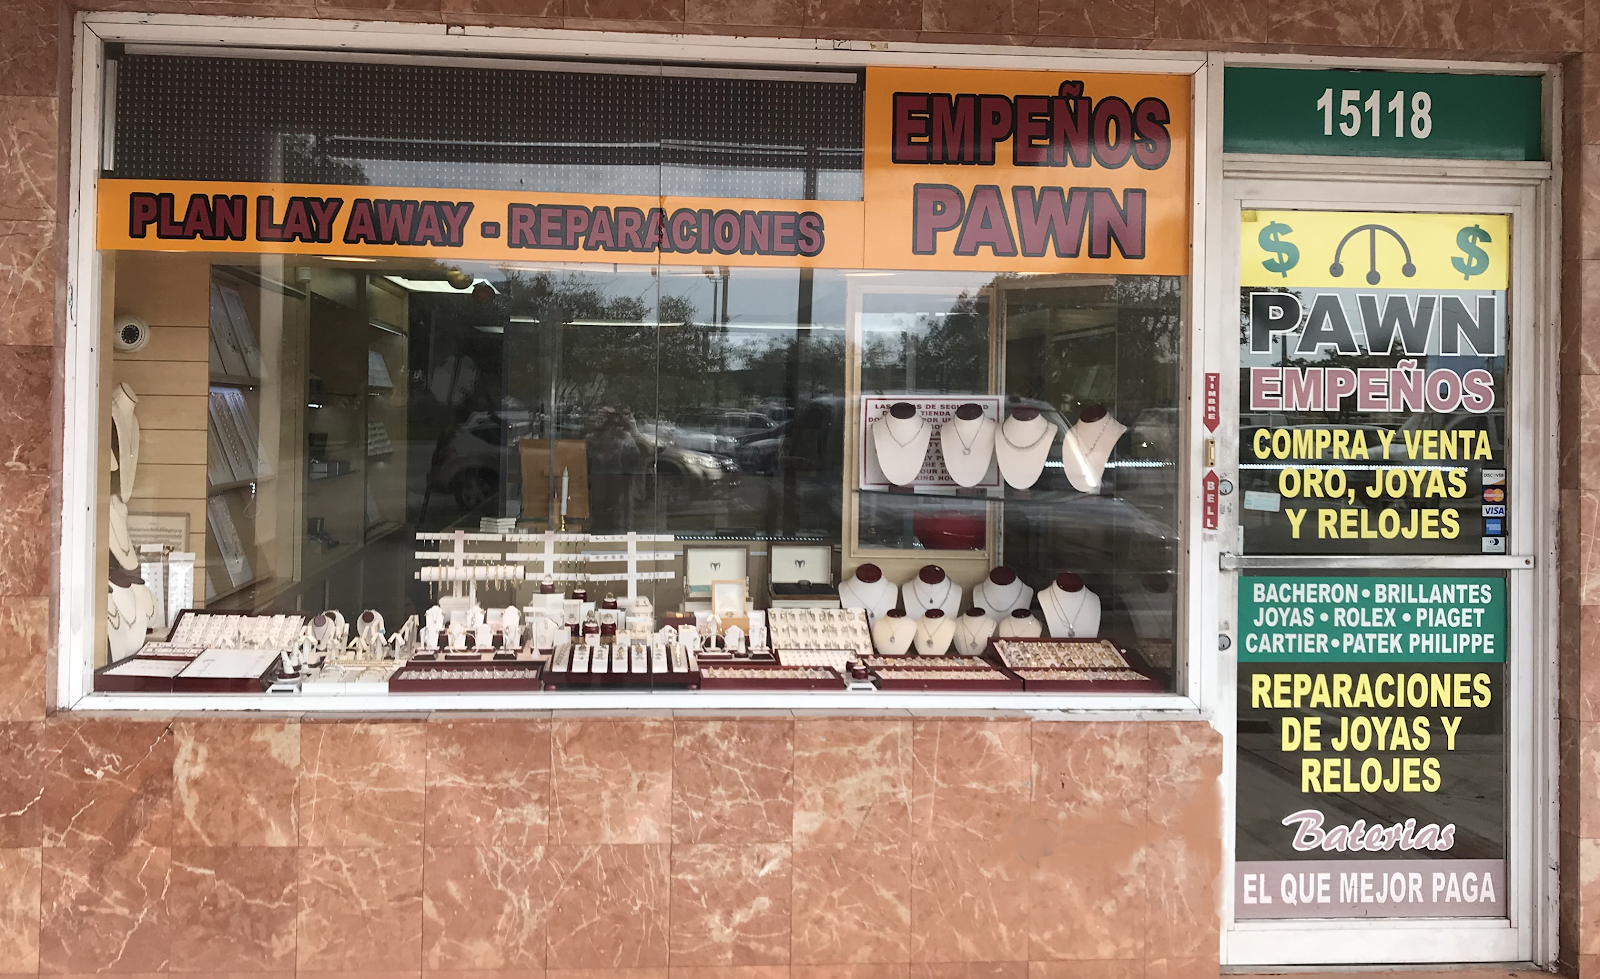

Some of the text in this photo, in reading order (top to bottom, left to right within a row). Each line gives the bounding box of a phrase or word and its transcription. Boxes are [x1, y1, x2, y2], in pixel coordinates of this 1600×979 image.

[892, 81, 1171, 170] EMPEÑOS
[1316, 88, 1433, 139] 15118
[129, 192, 247, 241] PLAN
[256, 195, 344, 243] LAY
[343, 198, 474, 247] AWAY
[507, 202, 825, 257] REPARACIONES
[912, 183, 1146, 259] PAWN
[1249, 292, 1498, 357] PAWN
[1207, 375, 1217, 420] TIMBRE
[1249, 359, 1495, 414] EMPEÑOS
[1253, 428, 1493, 461] COMPRA Y VENTA
[1206, 481, 1216, 528] BELL
[1278, 467, 1356, 505] ORO,
[1366, 468, 1468, 498] JOYAS
[1284, 508, 1461, 539] Y RELOJES
[1485, 507, 1504, 515] VISA
[1253, 607, 1485, 628] JOYAS ROLEX PIAGET
[1409, 633, 1495, 654] PHILIPPE
[1251, 672, 1492, 708] REPARACIONES
[1281, 716, 1462, 751] DE JOYAS Y
[1301, 757, 1442, 793] RELOJES
[1281, 809, 1456, 852] Baterias
[1243, 872, 1496, 906] EL QUE MEJOR PAGA
